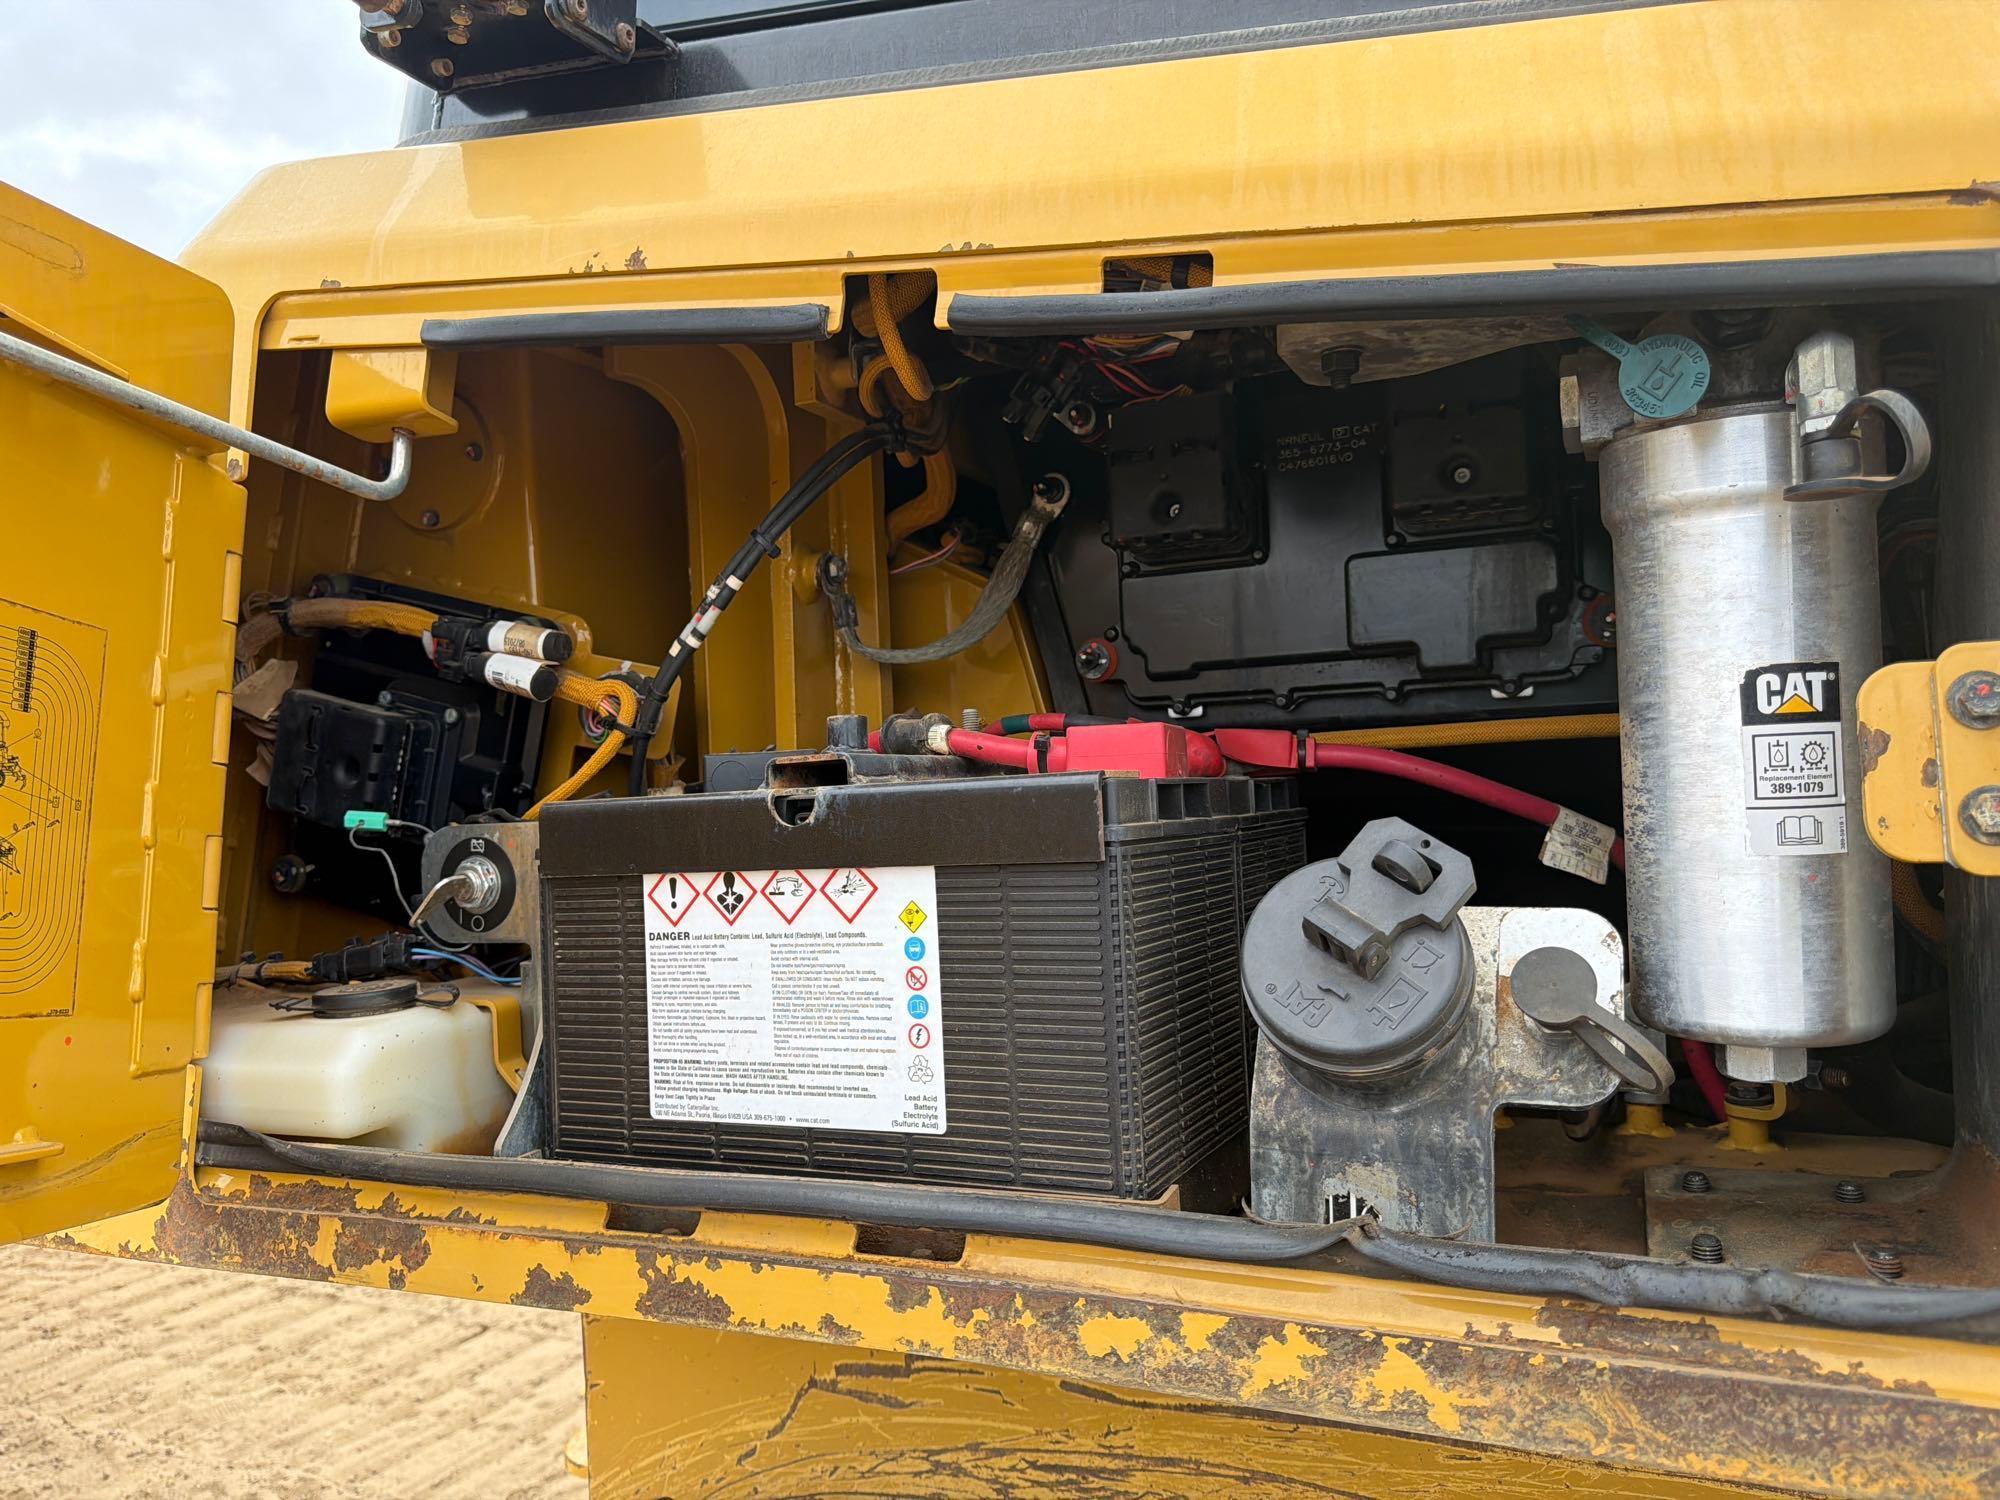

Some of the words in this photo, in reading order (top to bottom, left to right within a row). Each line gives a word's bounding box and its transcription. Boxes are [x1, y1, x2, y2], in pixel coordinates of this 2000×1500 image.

[1640, 335, 1703, 364] HYDRAULIC
[1691, 372, 1706, 390] OIL
[1352, 424, 1377, 436] CAT
[1770, 782, 1824, 794] 389-1079
[649, 932, 690, 940] DANGER
[912, 1103, 938, 1111] Battery
[903, 1112, 938, 1121] Electrolyte
[891, 1119, 919, 1128] (Sulfuric
[921, 1121, 938, 1129] Acid)
